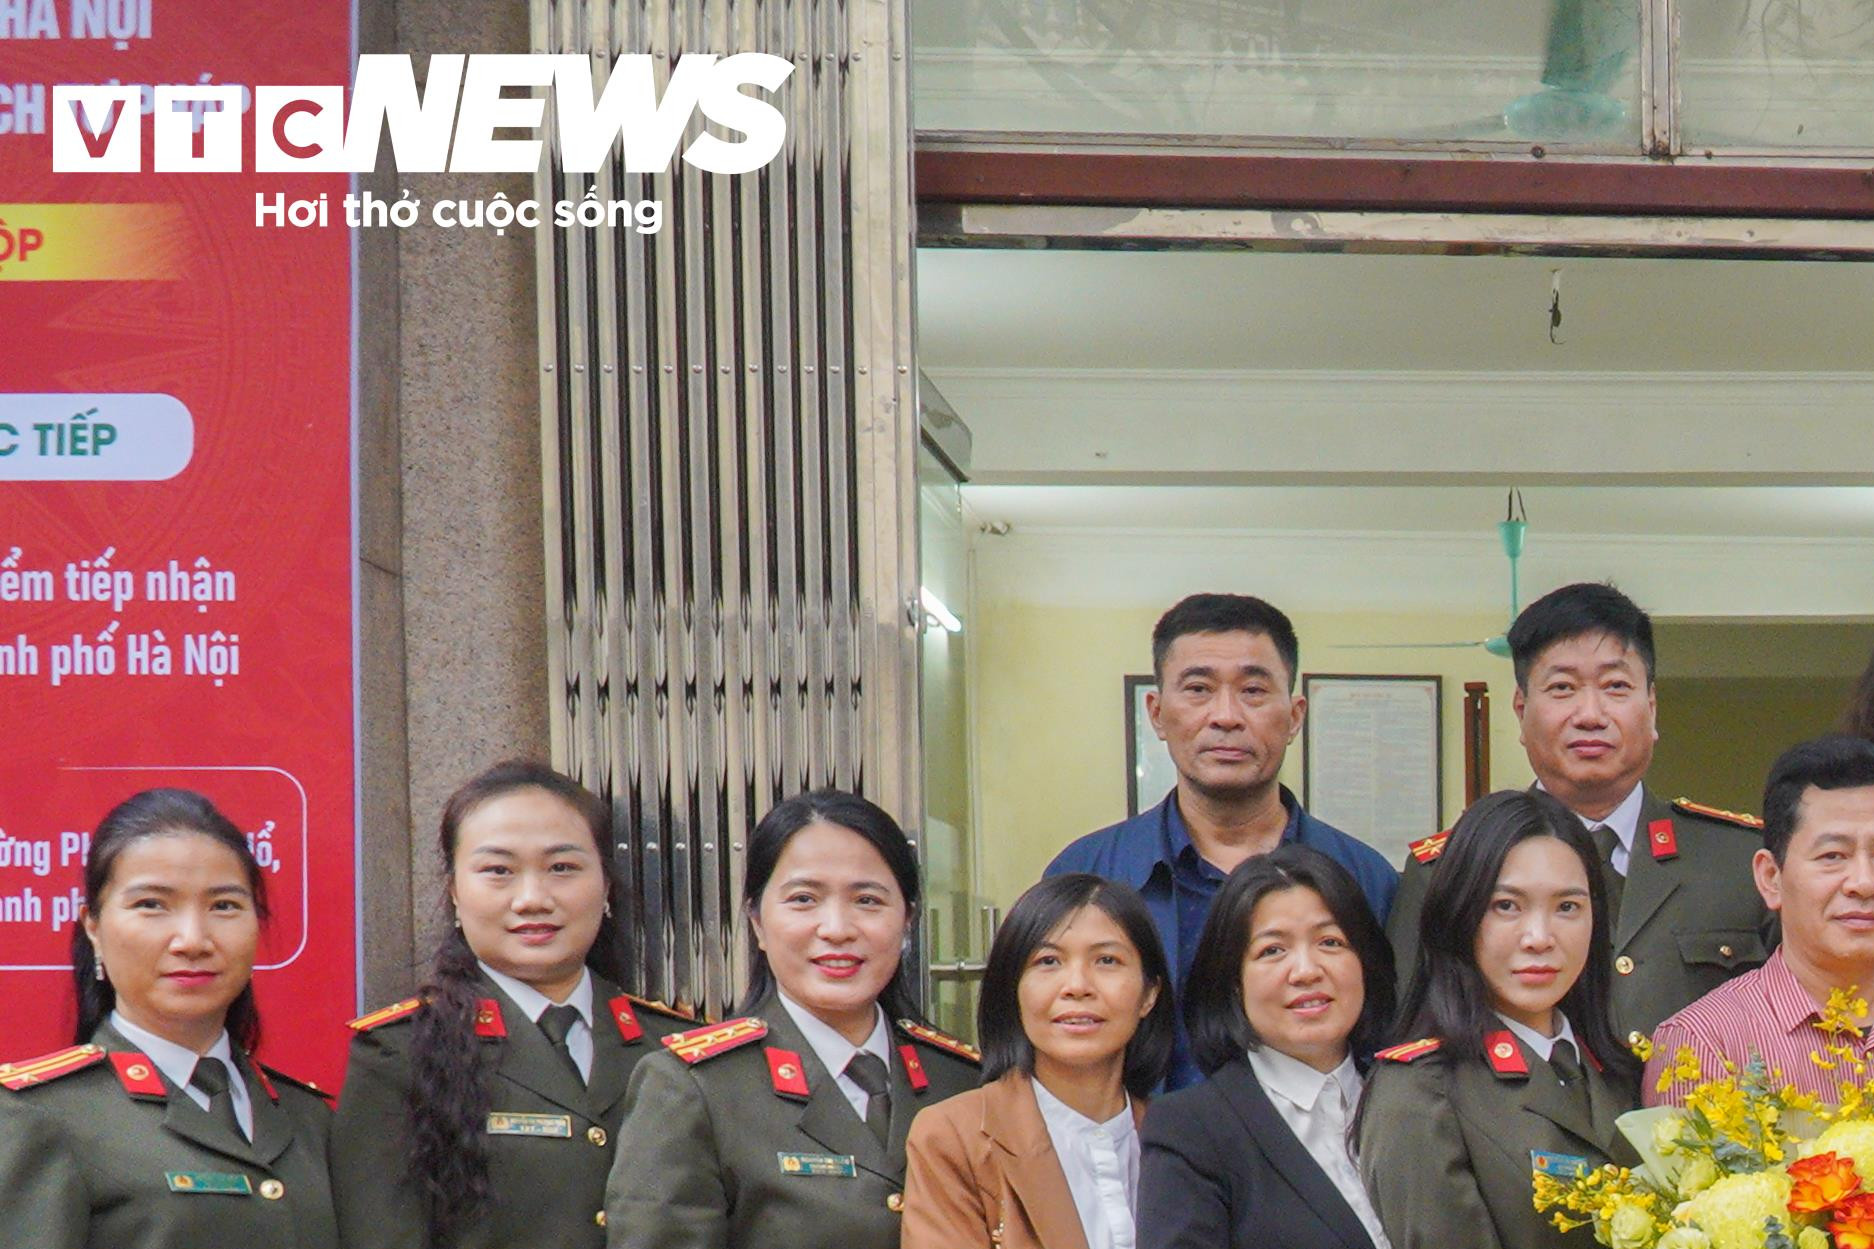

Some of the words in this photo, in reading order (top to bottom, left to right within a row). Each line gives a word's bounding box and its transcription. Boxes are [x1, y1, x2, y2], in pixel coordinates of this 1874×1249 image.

[33, 407, 118, 457] TIẾP
[64, 546, 135, 613] tiếp
[146, 556, 237, 613] nhận
[51, 620, 121, 687] phố
[127, 629, 172, 676] Hà
[184, 629, 240, 687] Nội
